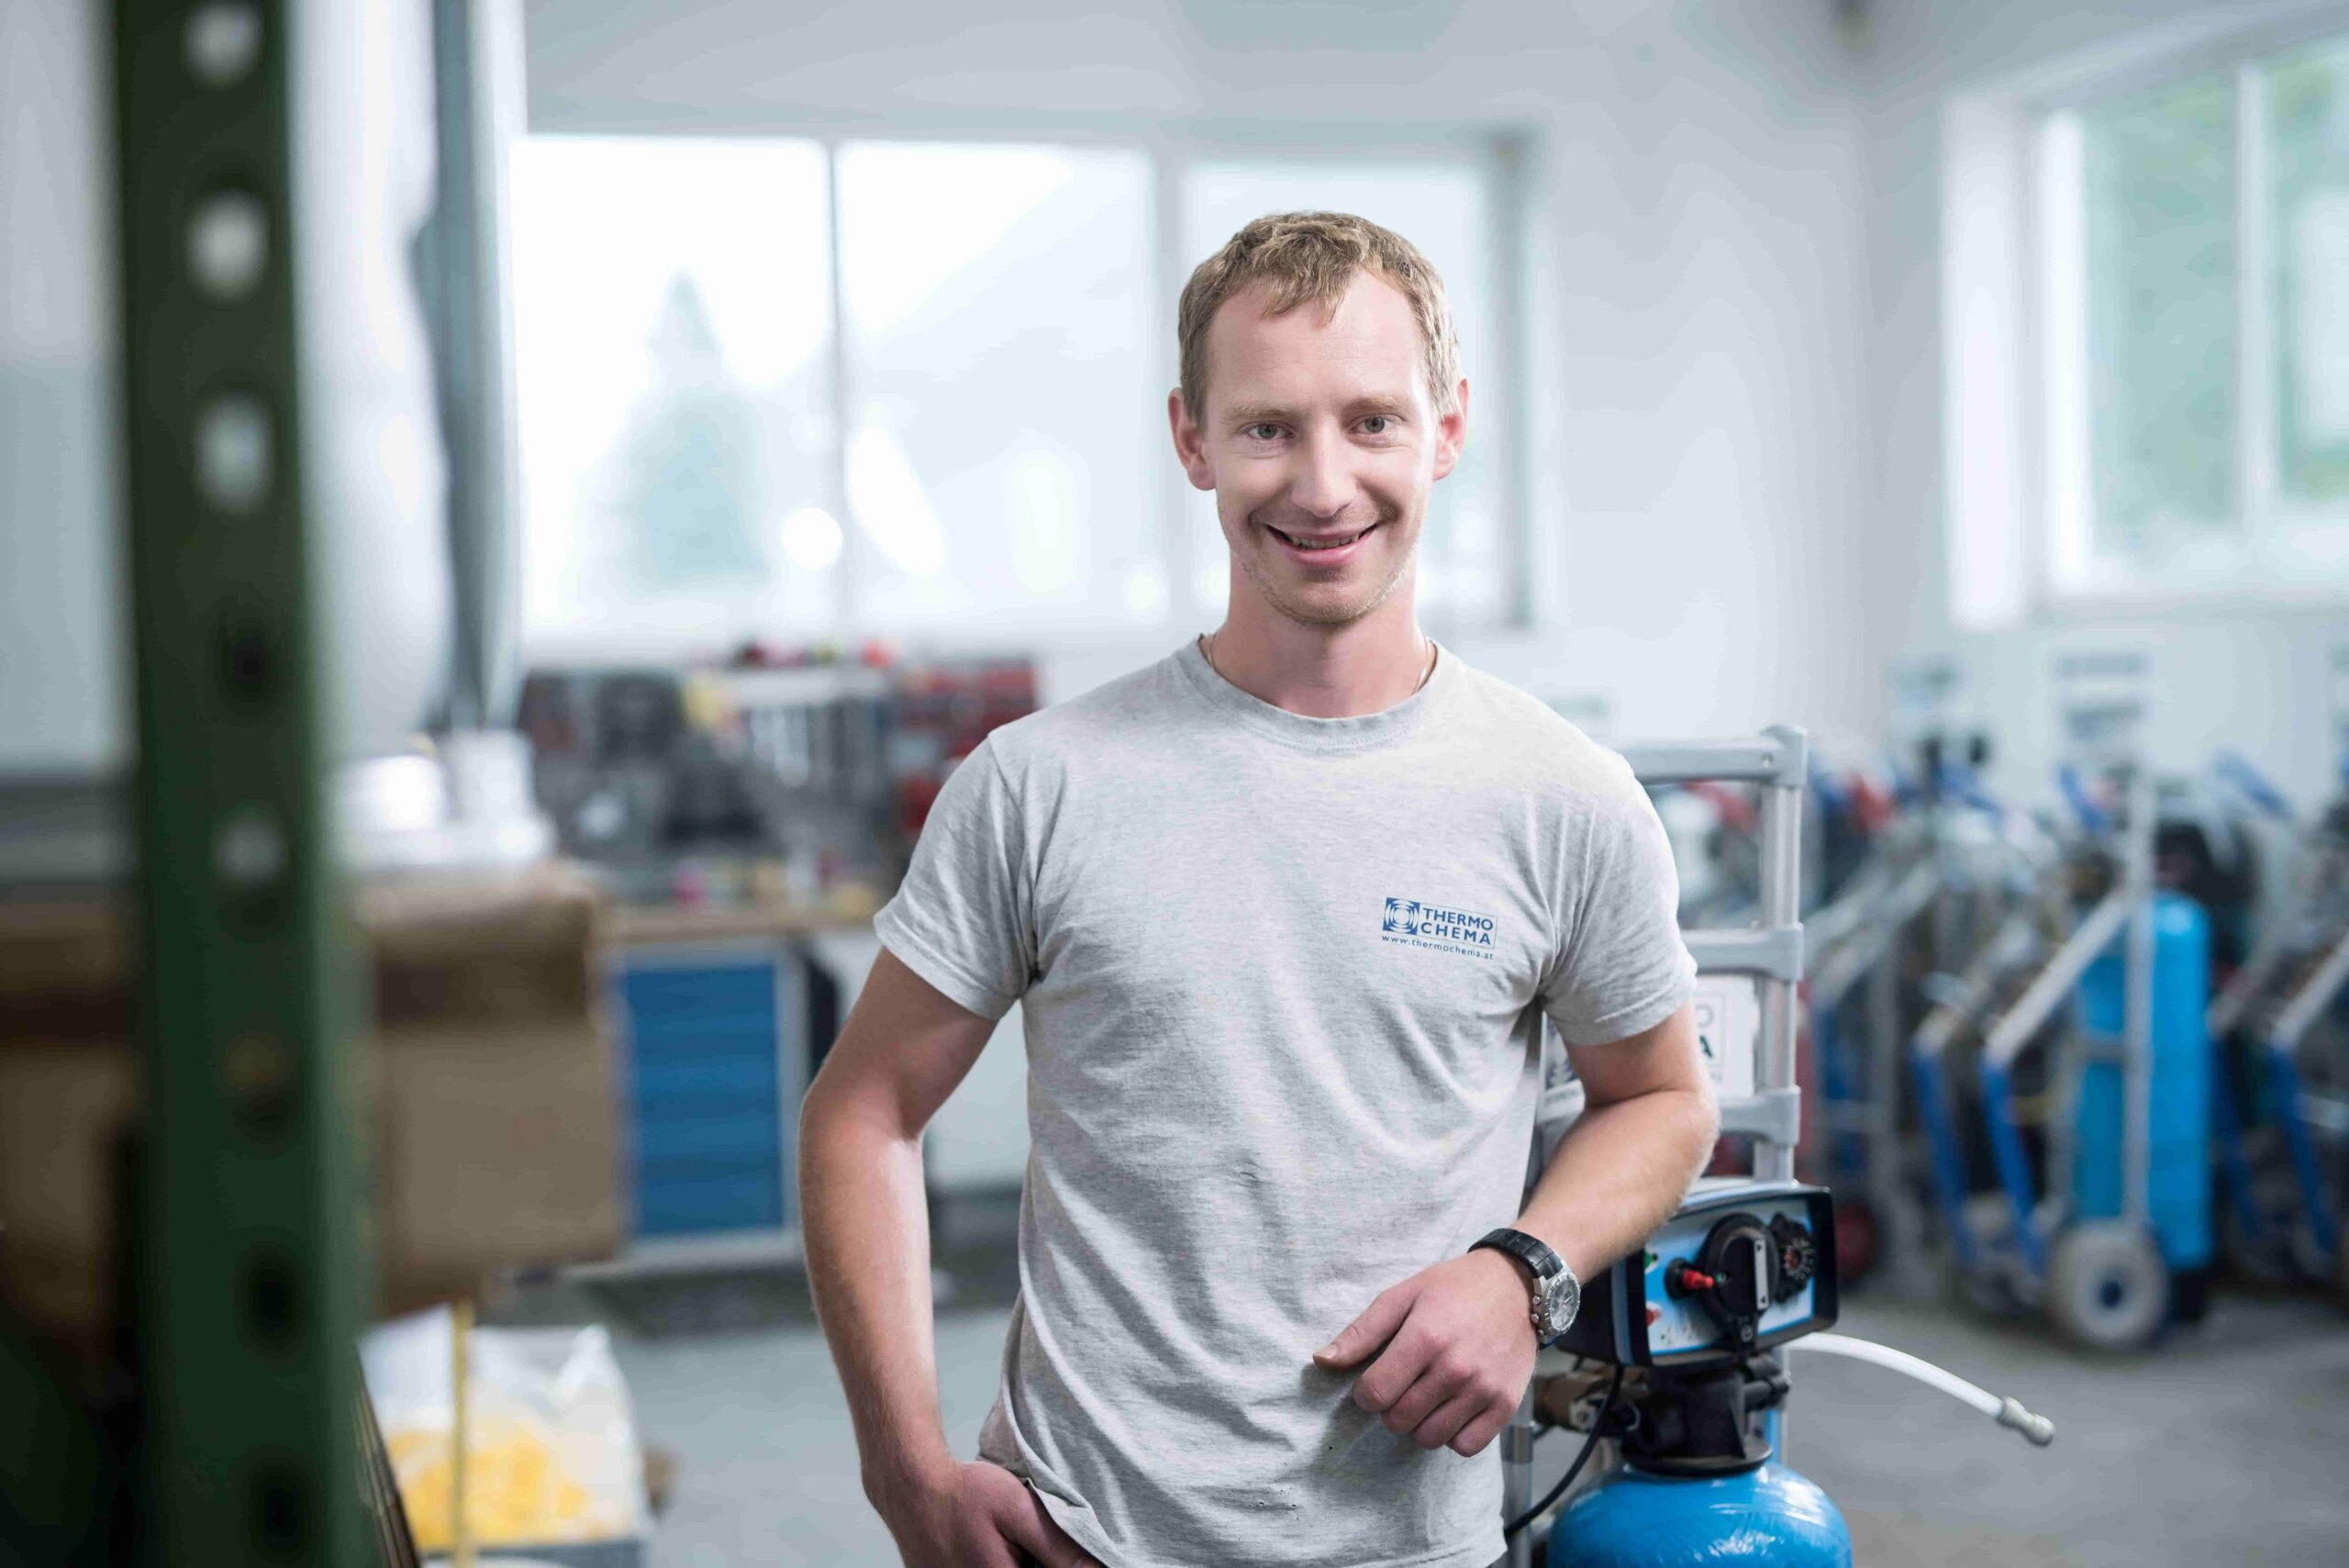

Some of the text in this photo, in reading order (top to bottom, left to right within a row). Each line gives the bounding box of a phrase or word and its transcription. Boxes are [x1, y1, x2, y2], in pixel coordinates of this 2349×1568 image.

[1422, 907, 1494, 931] THERMO
[1420, 922, 1491, 945] CHEMA
[1382, 935, 1494, 960] www.thermochema.at
